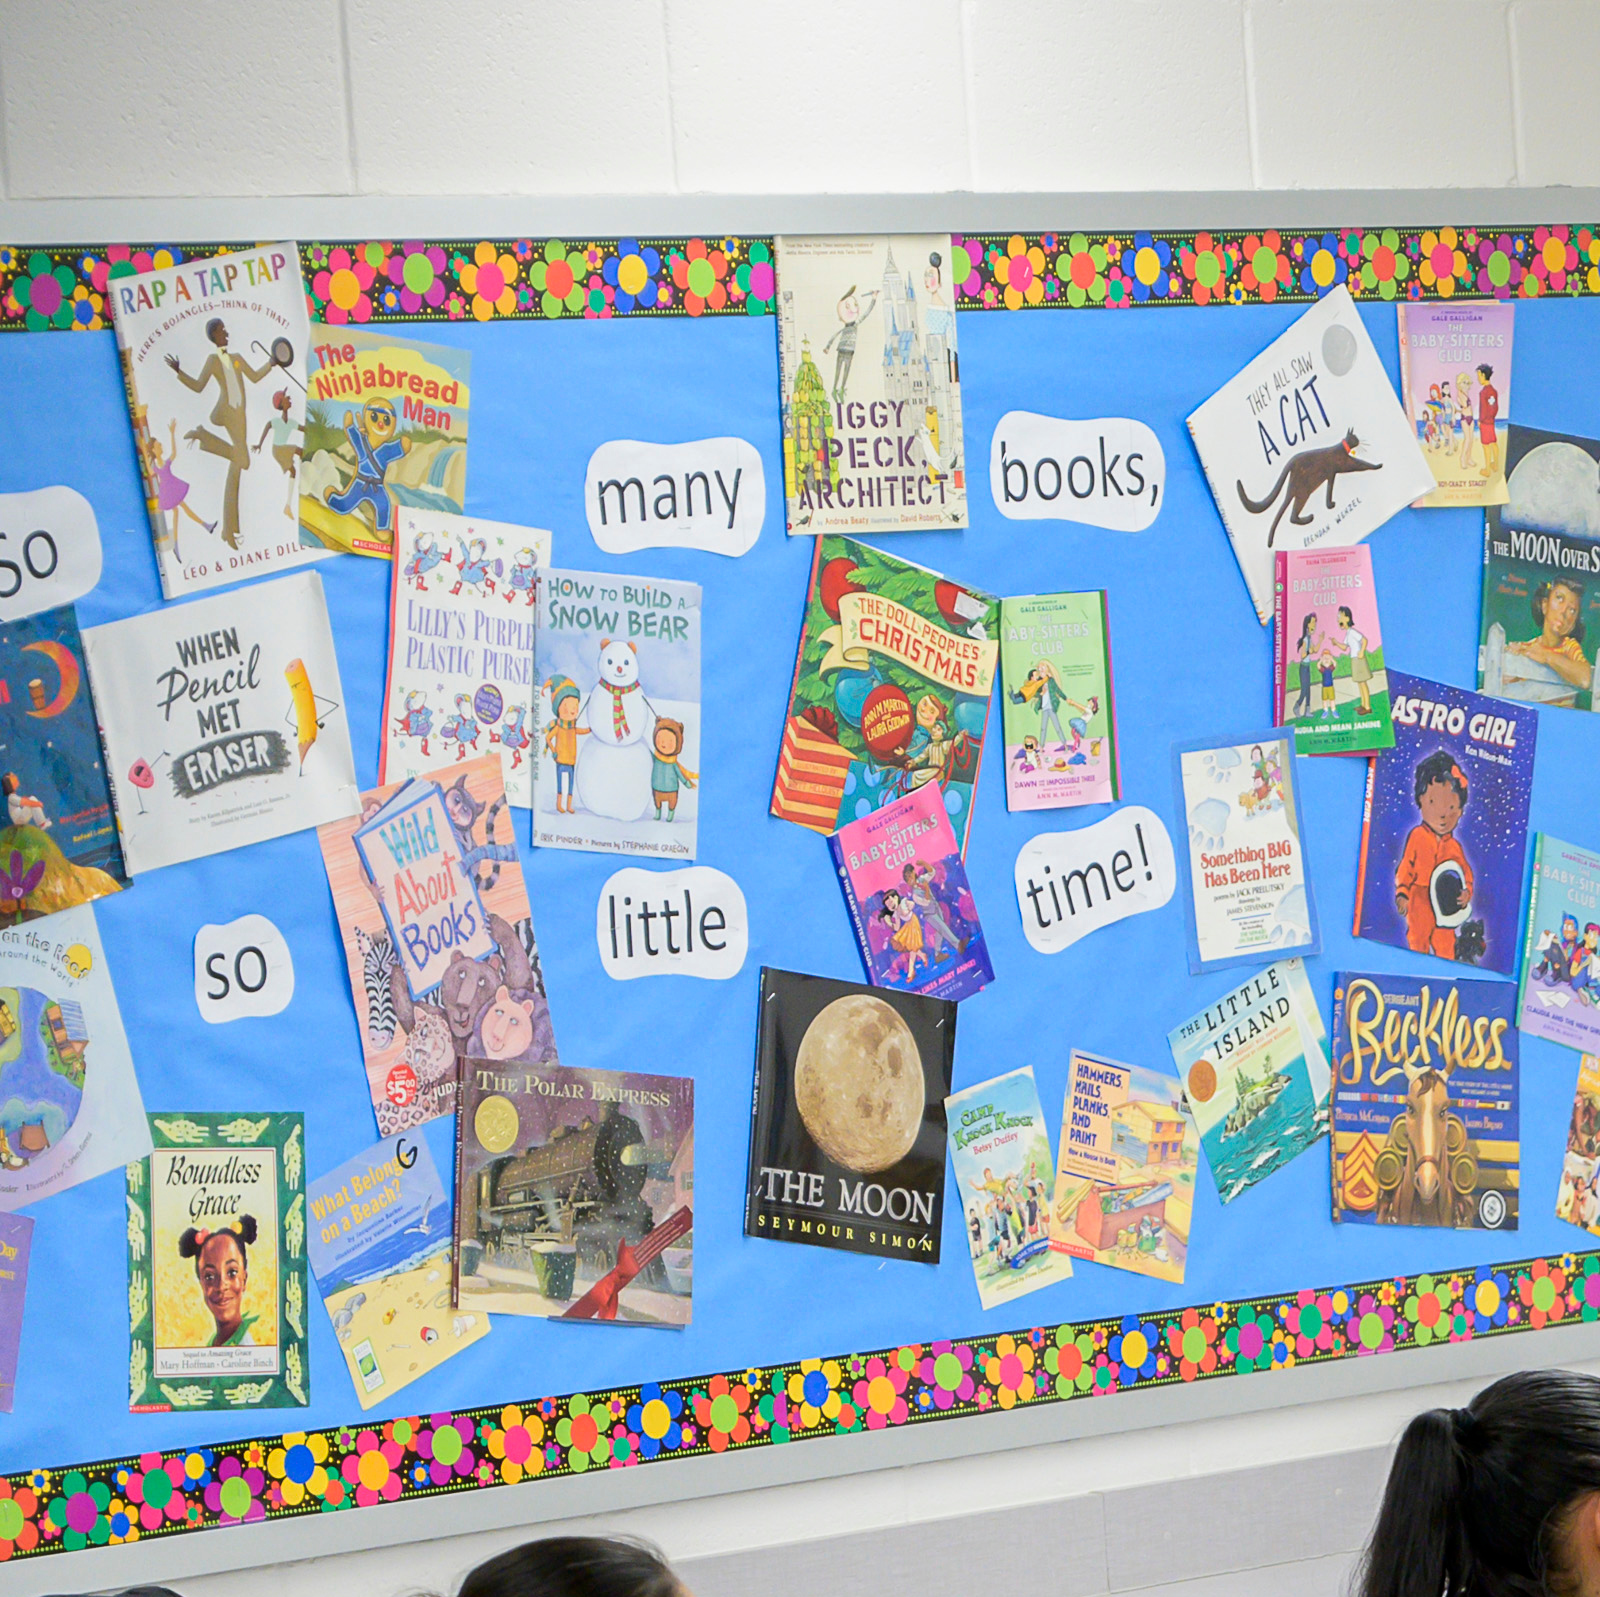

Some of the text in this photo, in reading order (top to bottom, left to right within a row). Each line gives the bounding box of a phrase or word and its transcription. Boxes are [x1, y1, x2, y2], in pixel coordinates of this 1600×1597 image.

[120, 252, 286, 315] RAP A TAP TAP
[137, 302, 289, 362] HERE'S OF THAT!
[1411, 324, 1505, 364] THE BABY-SITTERS CLUB
[314, 343, 355, 370] The
[316, 363, 458, 405] Ninjabread
[1247, 351, 1313, 416] THEY ALL SAW
[402, 396, 451, 430] Man
[836, 401, 905, 430] IGGY
[1256, 374, 1331, 465] A CAT
[823, 436, 928, 470] PECK,
[1001, 436, 1159, 507] books,
[598, 468, 743, 528] many
[798, 475, 948, 510] ARCHITECT
[183, 551, 271, 580] LEO & DIANE
[1493, 540, 1509, 557] THE
[1510, 531, 1560, 569] MOON
[1562, 549, 1590, 572] OVER
[548, 578, 686, 609] HOW TO BUILD A
[407, 600, 534, 650] LILLY'S PURPLE
[548, 599, 689, 642] SNOW BEAR
[858, 597, 980, 661] THE DOLL PEOPLE'S
[176, 628, 241, 667] WHEN
[406, 637, 531, 685] PLASTIC PURSE
[860, 618, 976, 688] CHRISTMAS
[157, 644, 261, 721] Pencil
[197, 698, 243, 738] MET
[1392, 695, 1517, 748] ASTRO GIRL
[184, 736, 271, 790] ERASER
[380, 807, 440, 868] Wild
[851, 814, 938, 871] BABY-SITTERS
[885, 823, 899, 834] THE
[885, 844, 915, 870] CLUB
[1201, 840, 1291, 869] Something BIG
[1205, 861, 1291, 888] Has Been Here
[394, 851, 457, 925] About
[1027, 823, 1153, 929] time!
[400, 900, 476, 972] Books
[609, 889, 727, 959] little
[205, 945, 267, 1000] so
[1180, 967, 1280, 1039] THE LITTLE
[1383, 993, 1420, 1007] SERGEANT
[1213, 997, 1290, 1060] ISLAND
[1341, 978, 1511, 1086] Reckless
[477, 1070, 671, 1107] THE POLAR EXPRESS
[952, 1110, 1034, 1151] KNOCK KNOCK
[960, 1103, 995, 1129] CAMP
[1072, 1112, 1090, 1128] AND
[973, 1131, 1019, 1157] Betsy Duffey
[1070, 1128, 1097, 1147] PAINT
[167, 1155, 261, 1186] Boundless
[188, 1188, 241, 1223] Grace
[310, 1186, 351, 1221] What
[321, 1179, 402, 1244] on a Beach?
[761, 1166, 935, 1225] THE MOON
[758, 1214, 933, 1252] SEYMOUR SIMON
